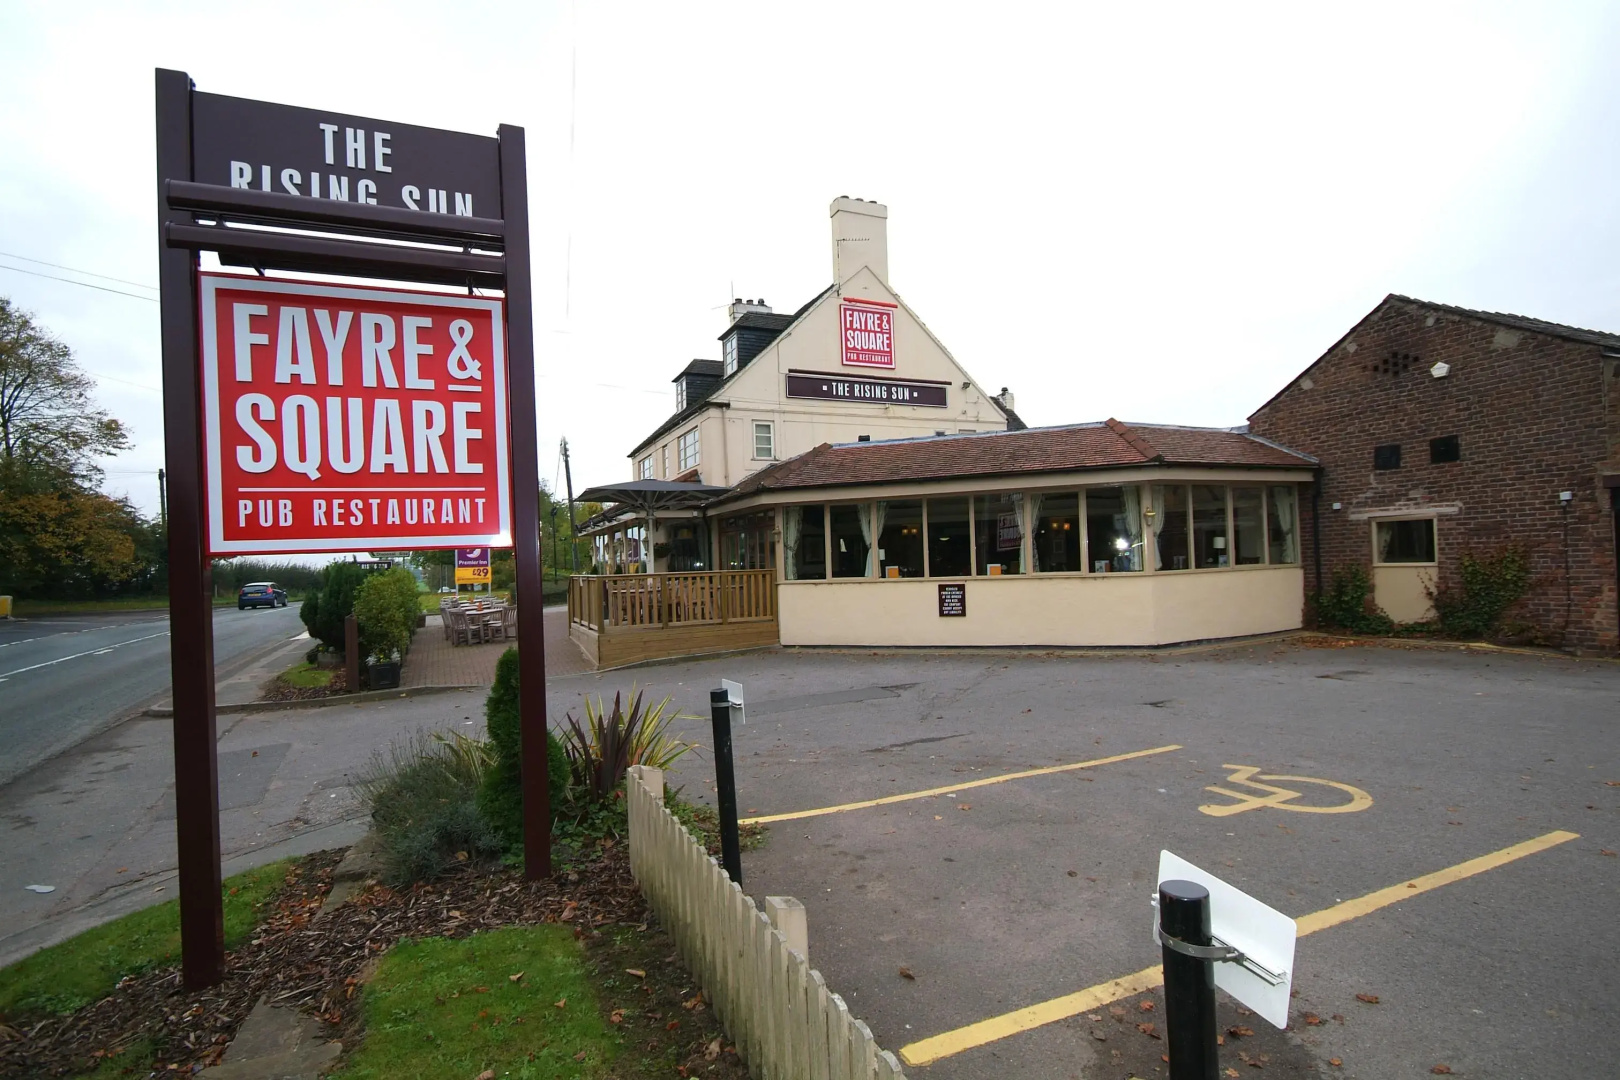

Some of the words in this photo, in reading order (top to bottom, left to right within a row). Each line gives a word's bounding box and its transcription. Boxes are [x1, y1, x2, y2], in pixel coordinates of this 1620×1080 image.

[319, 123, 392, 173] THE
[230, 160, 377, 205] RISING
[401, 185, 473, 217] SUN
[846, 310, 881, 331] FAYRE
[882, 315, 890, 330] &
[233, 302, 435, 390] FAYRE
[447, 319, 482, 381] &
[847, 330, 890, 351] SQUARE
[832, 382, 850, 396] THE
[854, 384, 887, 399] RISING
[891, 386, 909, 400] SUN
[235, 393, 484, 481] SQUARE
[238, 499, 293, 527] PUB
[313, 498, 486, 526] RESTAURANT
[472, 567, 489, 577] £29
